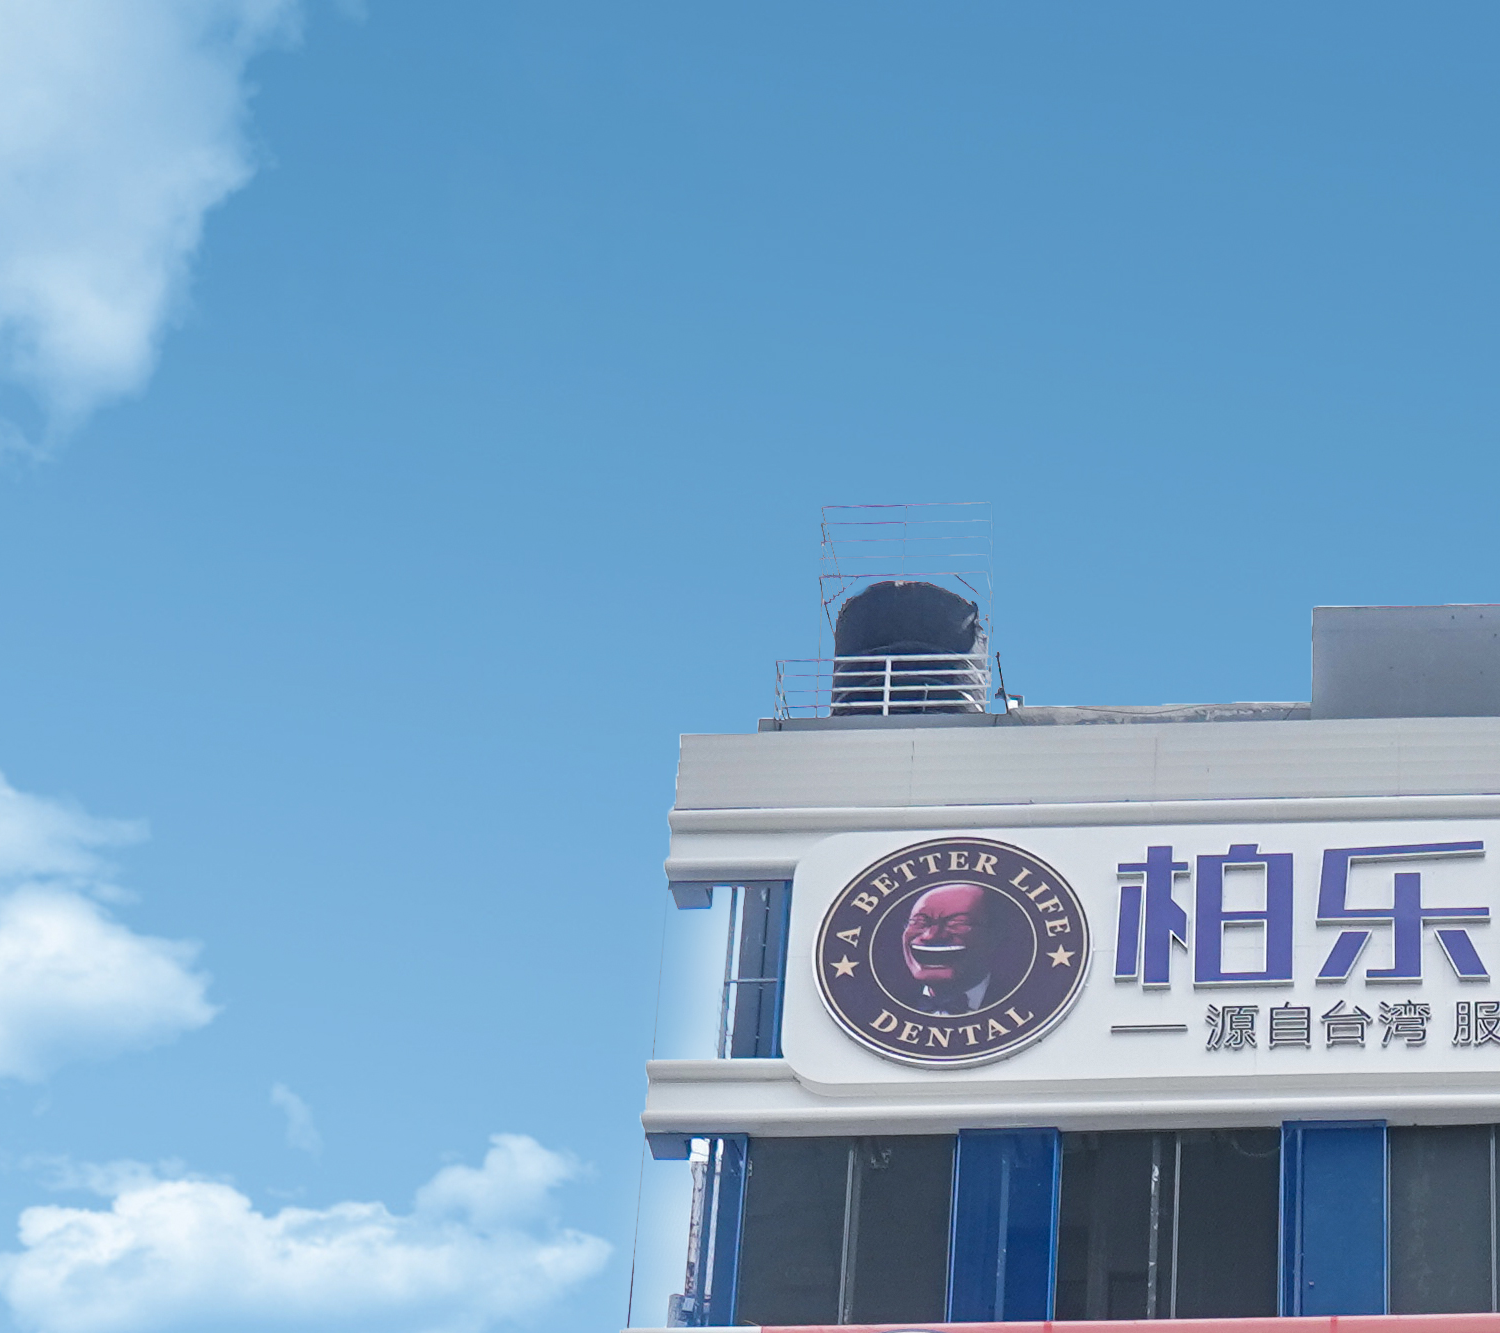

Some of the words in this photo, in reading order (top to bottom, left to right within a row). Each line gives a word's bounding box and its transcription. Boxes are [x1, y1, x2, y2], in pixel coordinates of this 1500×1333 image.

[836, 926, 861, 948] A
[851, 851, 999, 915] BETTER
[1009, 867, 1072, 937] LIFE
[869, 1008, 1034, 1048] DENTAL
[1204, 1001, 1431, 1053] 源自台湾
